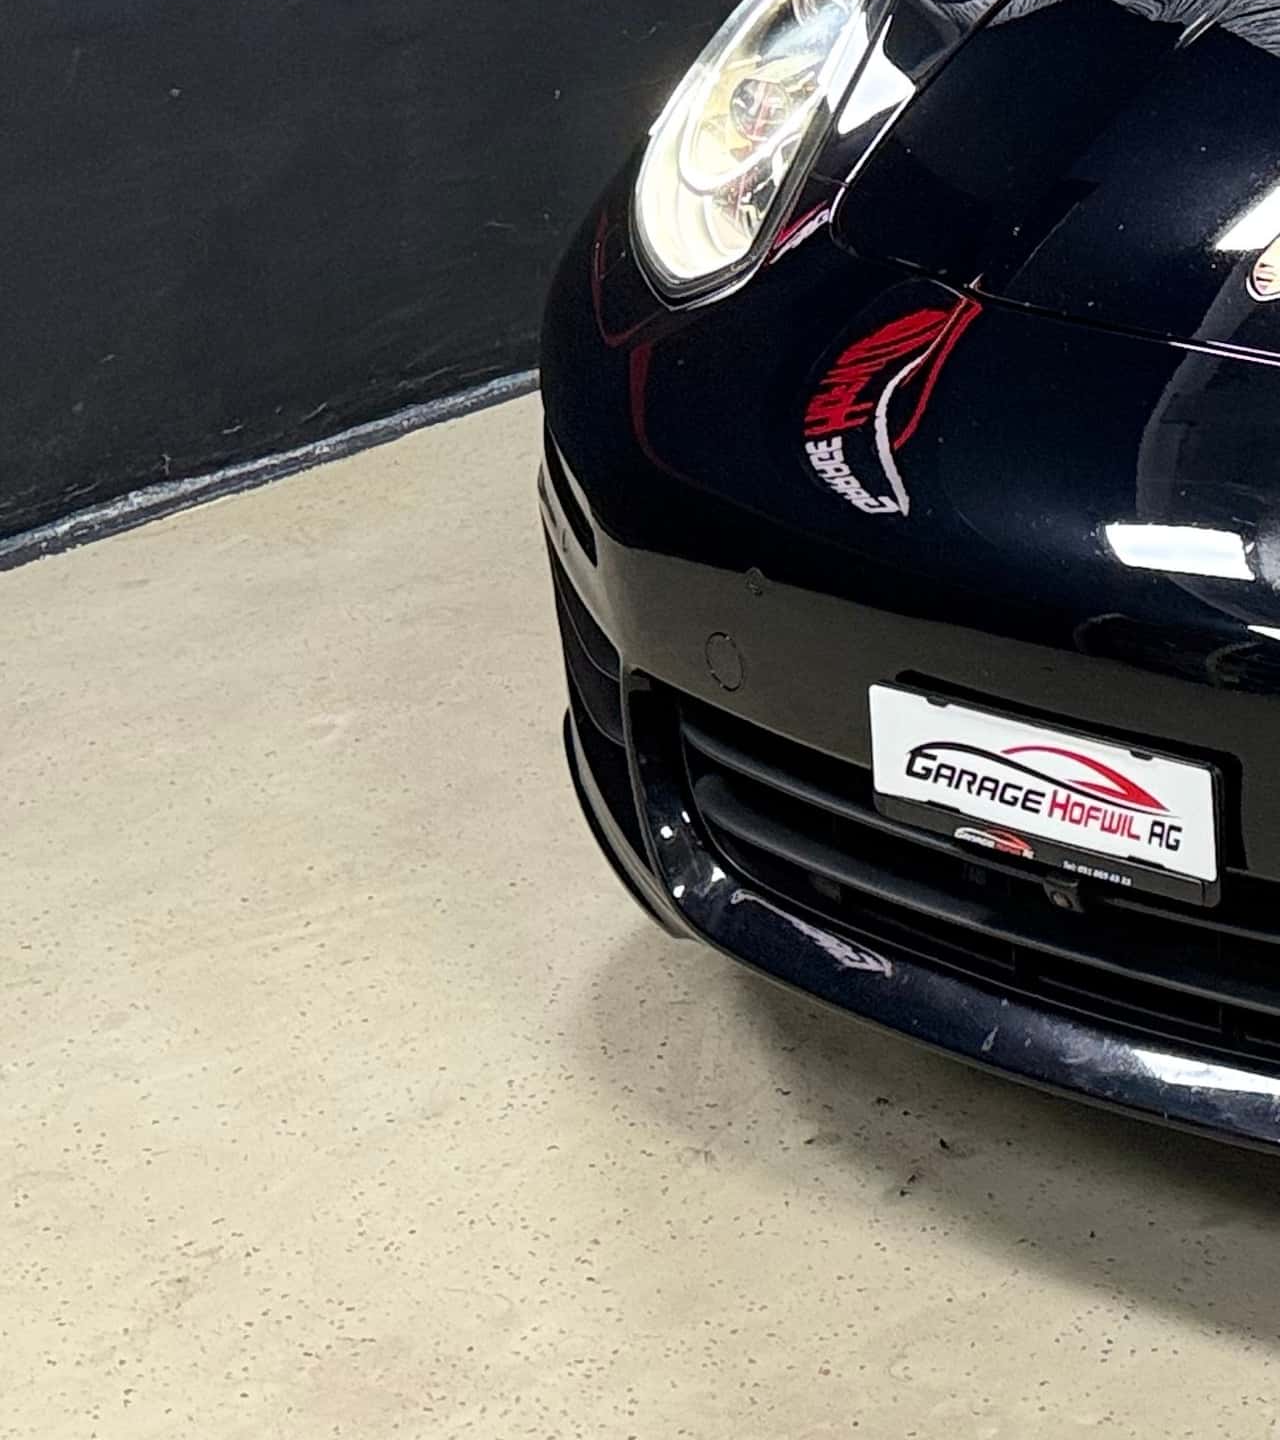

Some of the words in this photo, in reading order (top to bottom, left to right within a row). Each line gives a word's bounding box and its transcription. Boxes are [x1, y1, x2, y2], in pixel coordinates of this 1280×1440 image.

[904, 750, 1046, 815] GARAGE
[1047, 789, 1141, 841] HOFWIL
[1148, 820, 1183, 852] AG
